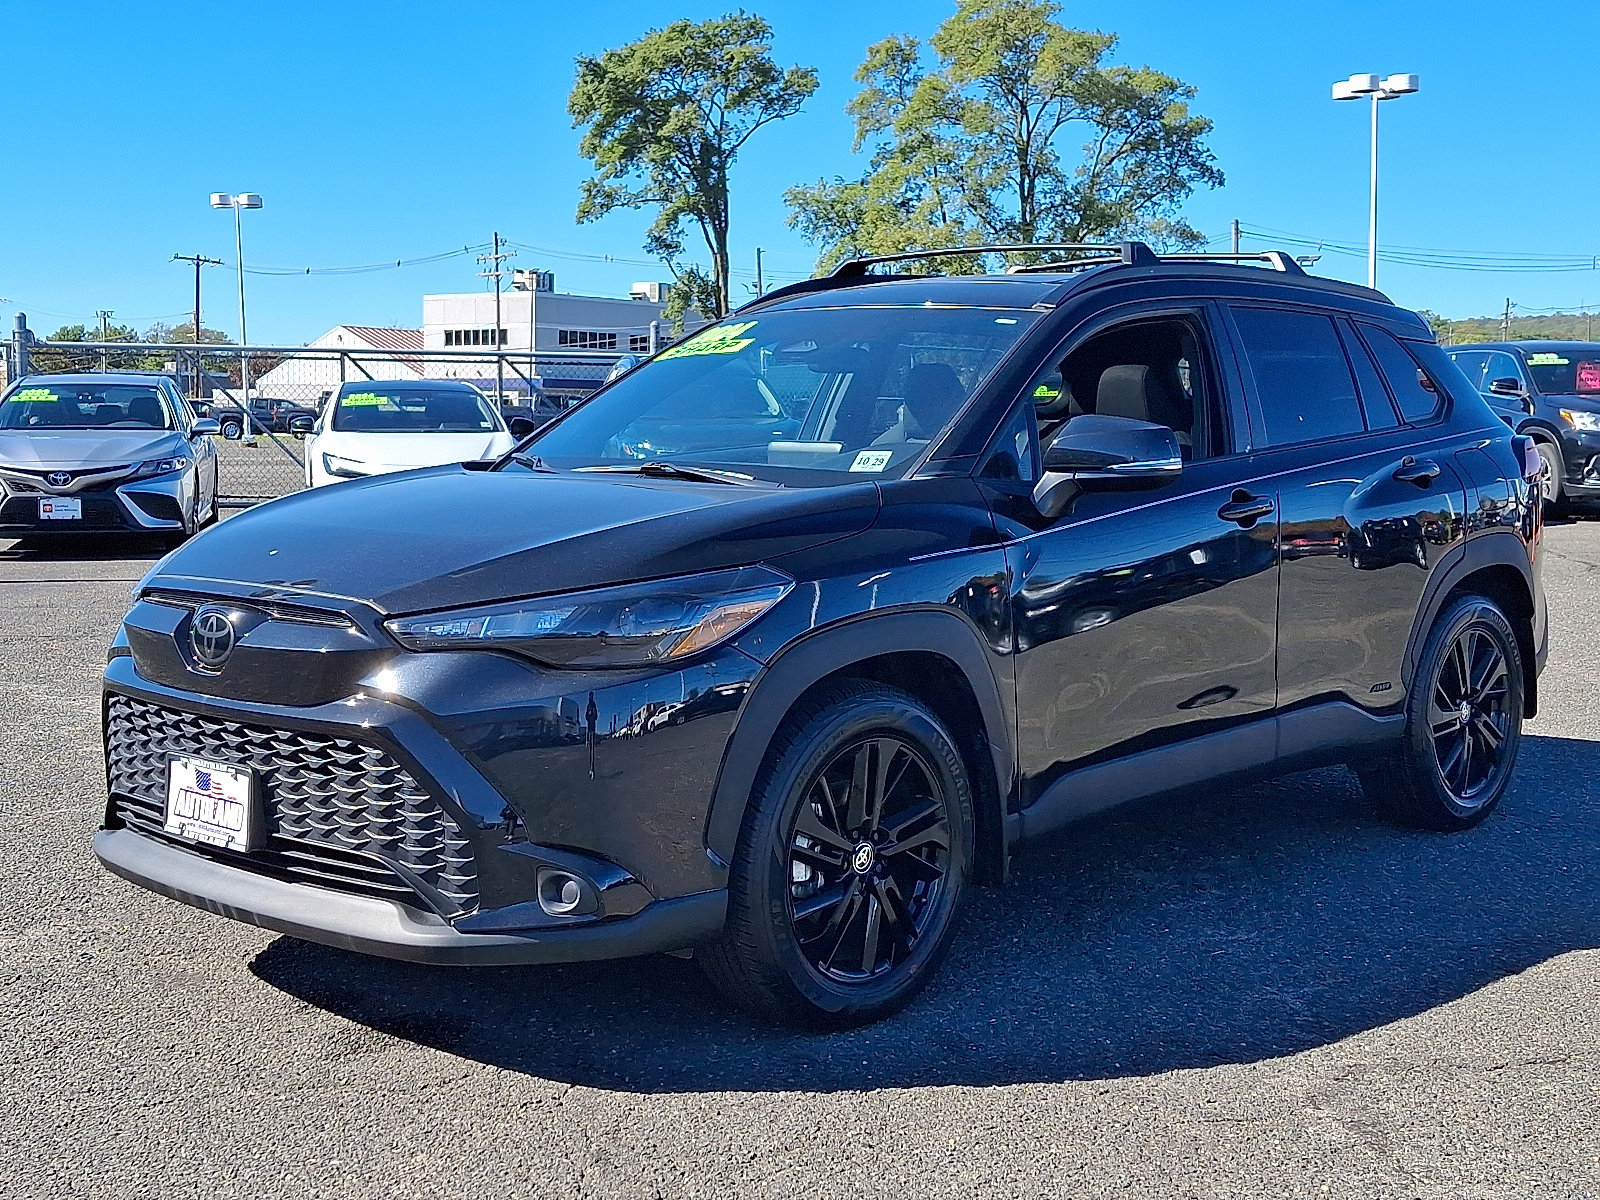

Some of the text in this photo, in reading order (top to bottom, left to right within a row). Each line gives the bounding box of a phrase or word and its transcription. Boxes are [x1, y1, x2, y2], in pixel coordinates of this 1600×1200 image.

[857, 457, 885, 466] 10 29
[174, 787, 245, 832] AUTOLAND
